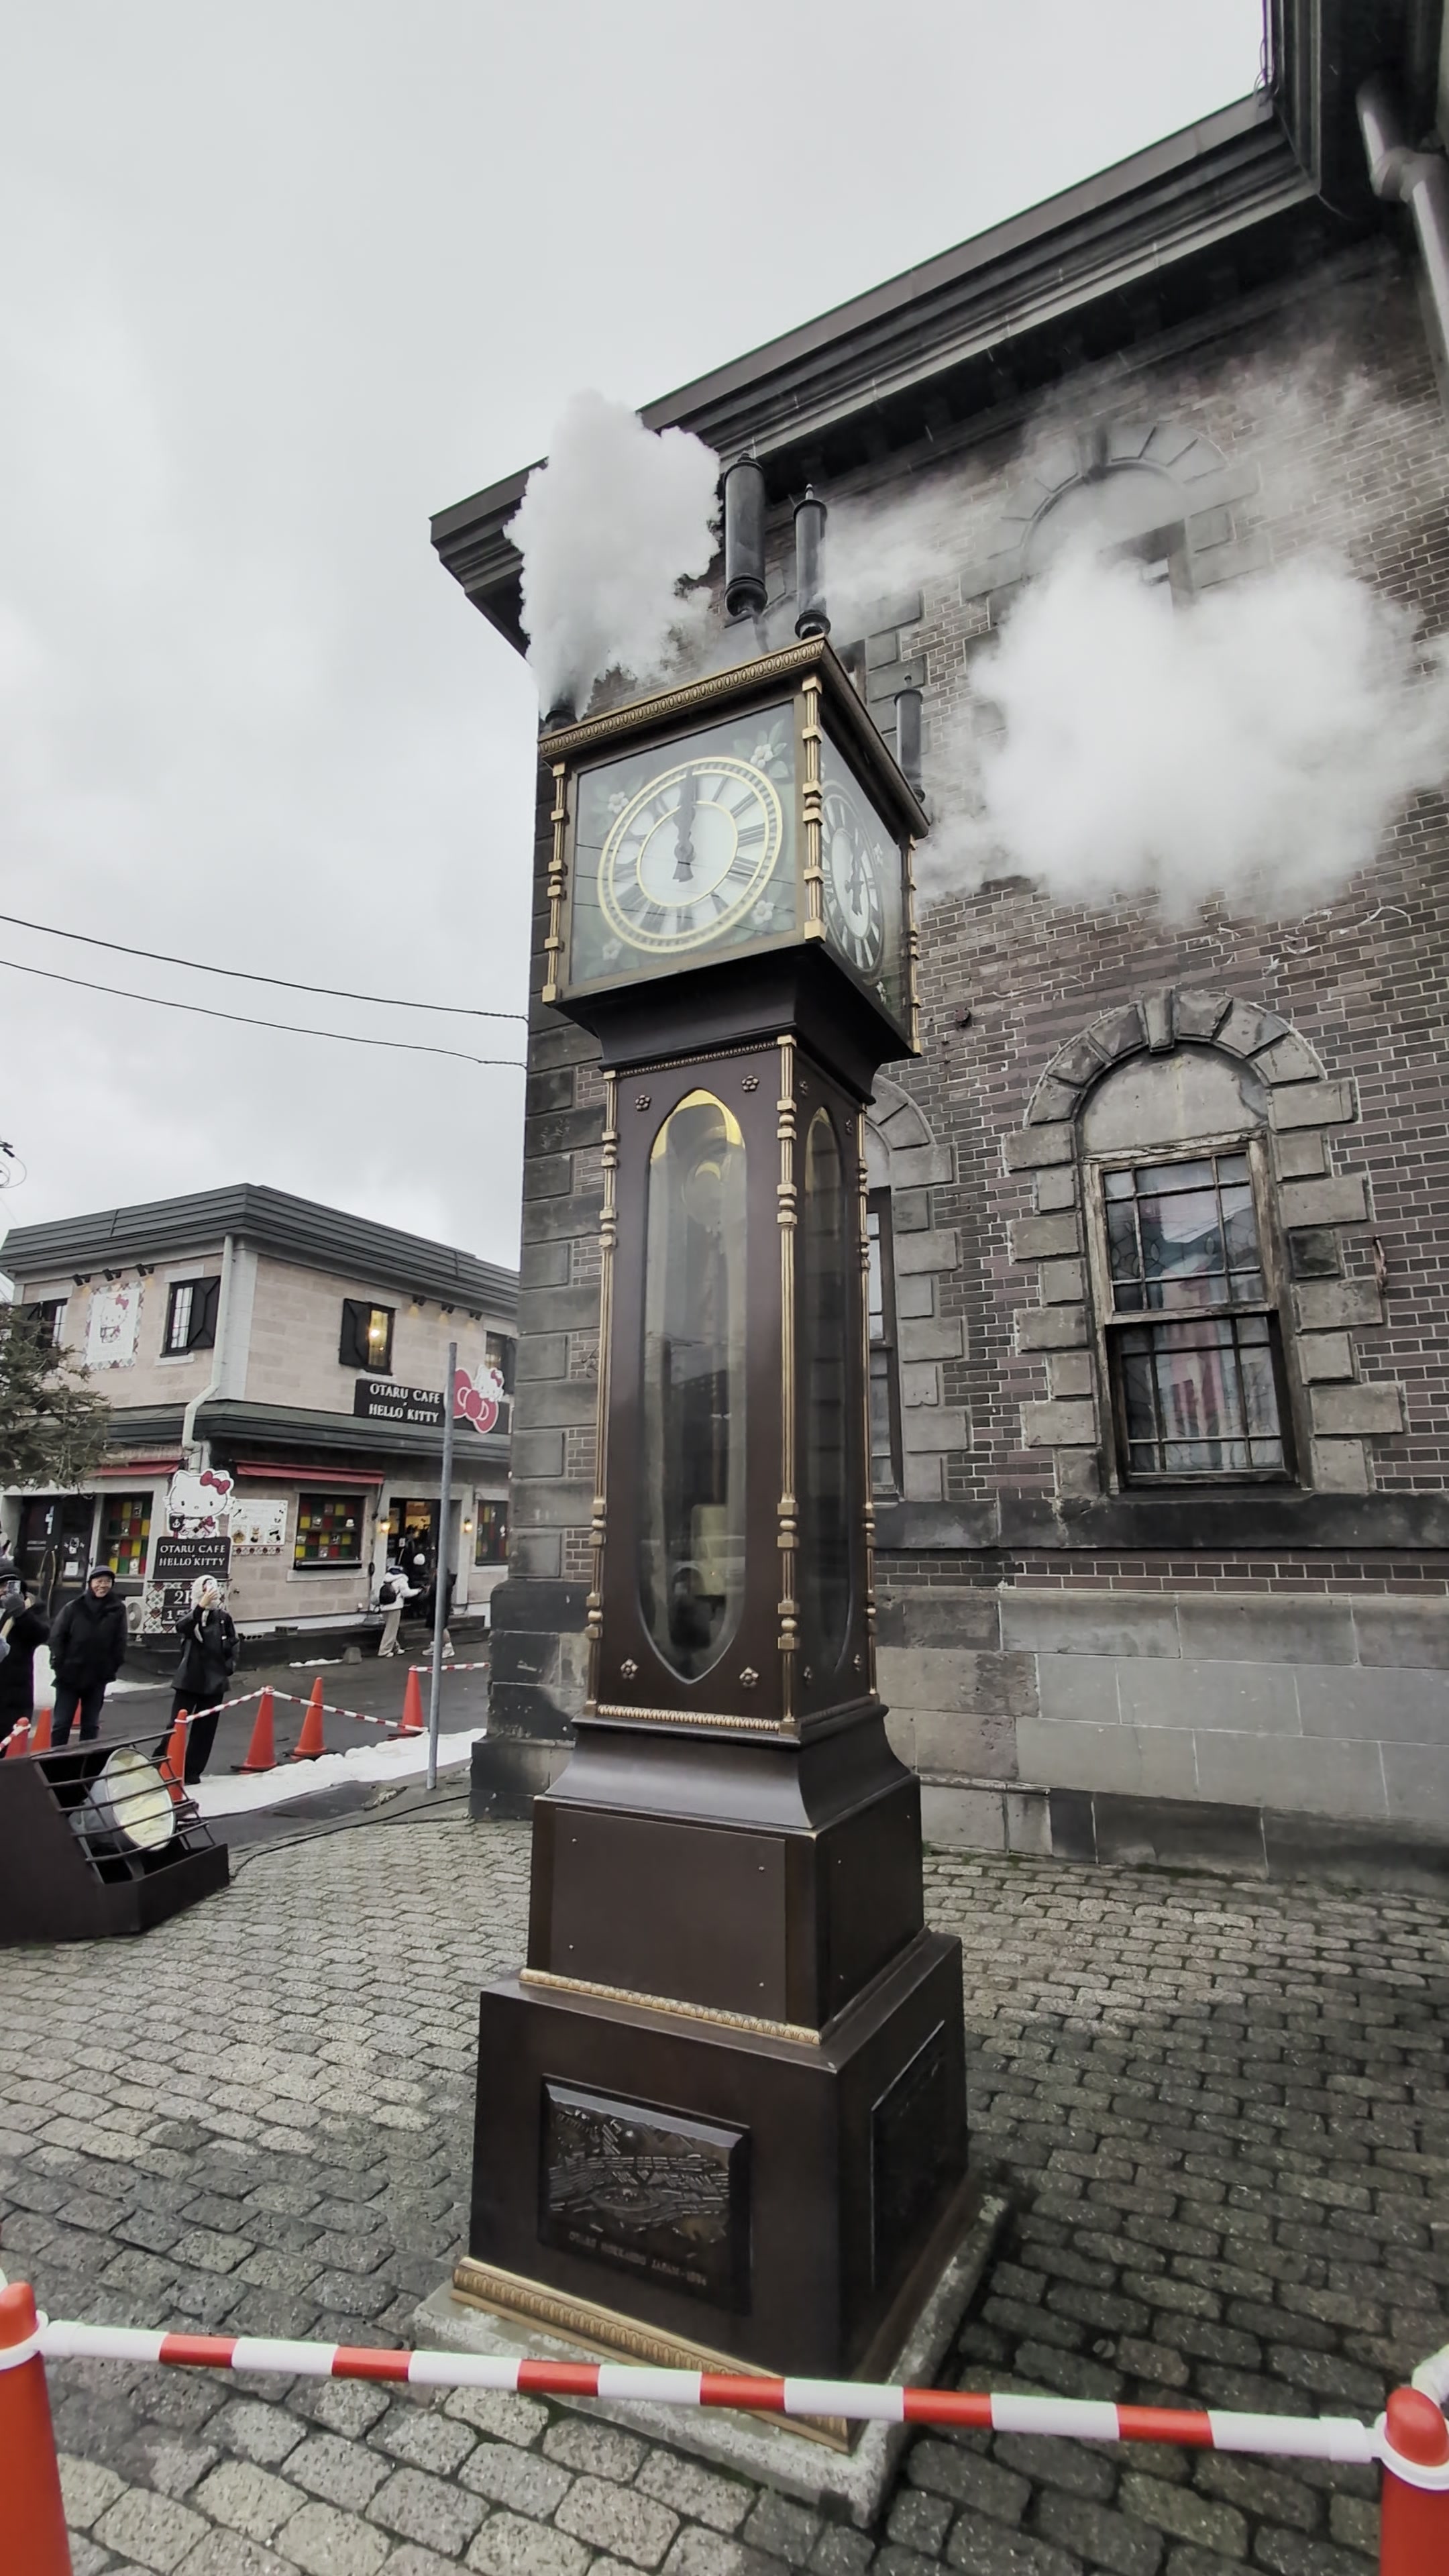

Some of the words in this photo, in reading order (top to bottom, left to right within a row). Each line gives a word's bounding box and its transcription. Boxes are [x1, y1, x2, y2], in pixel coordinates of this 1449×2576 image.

[370, 1384, 409, 1399] OTARU
[413, 1389, 441, 1405] CAFE
[368, 1403, 404, 1419] HELLO
[407, 1408, 439, 1423] KITTY
[160, 1544, 195, 1553] OTARU
[198, 1544, 226, 1554] CAFE
[158, 1557, 193, 1566] HELLO
[193, 1557, 225, 1566] KITTY
